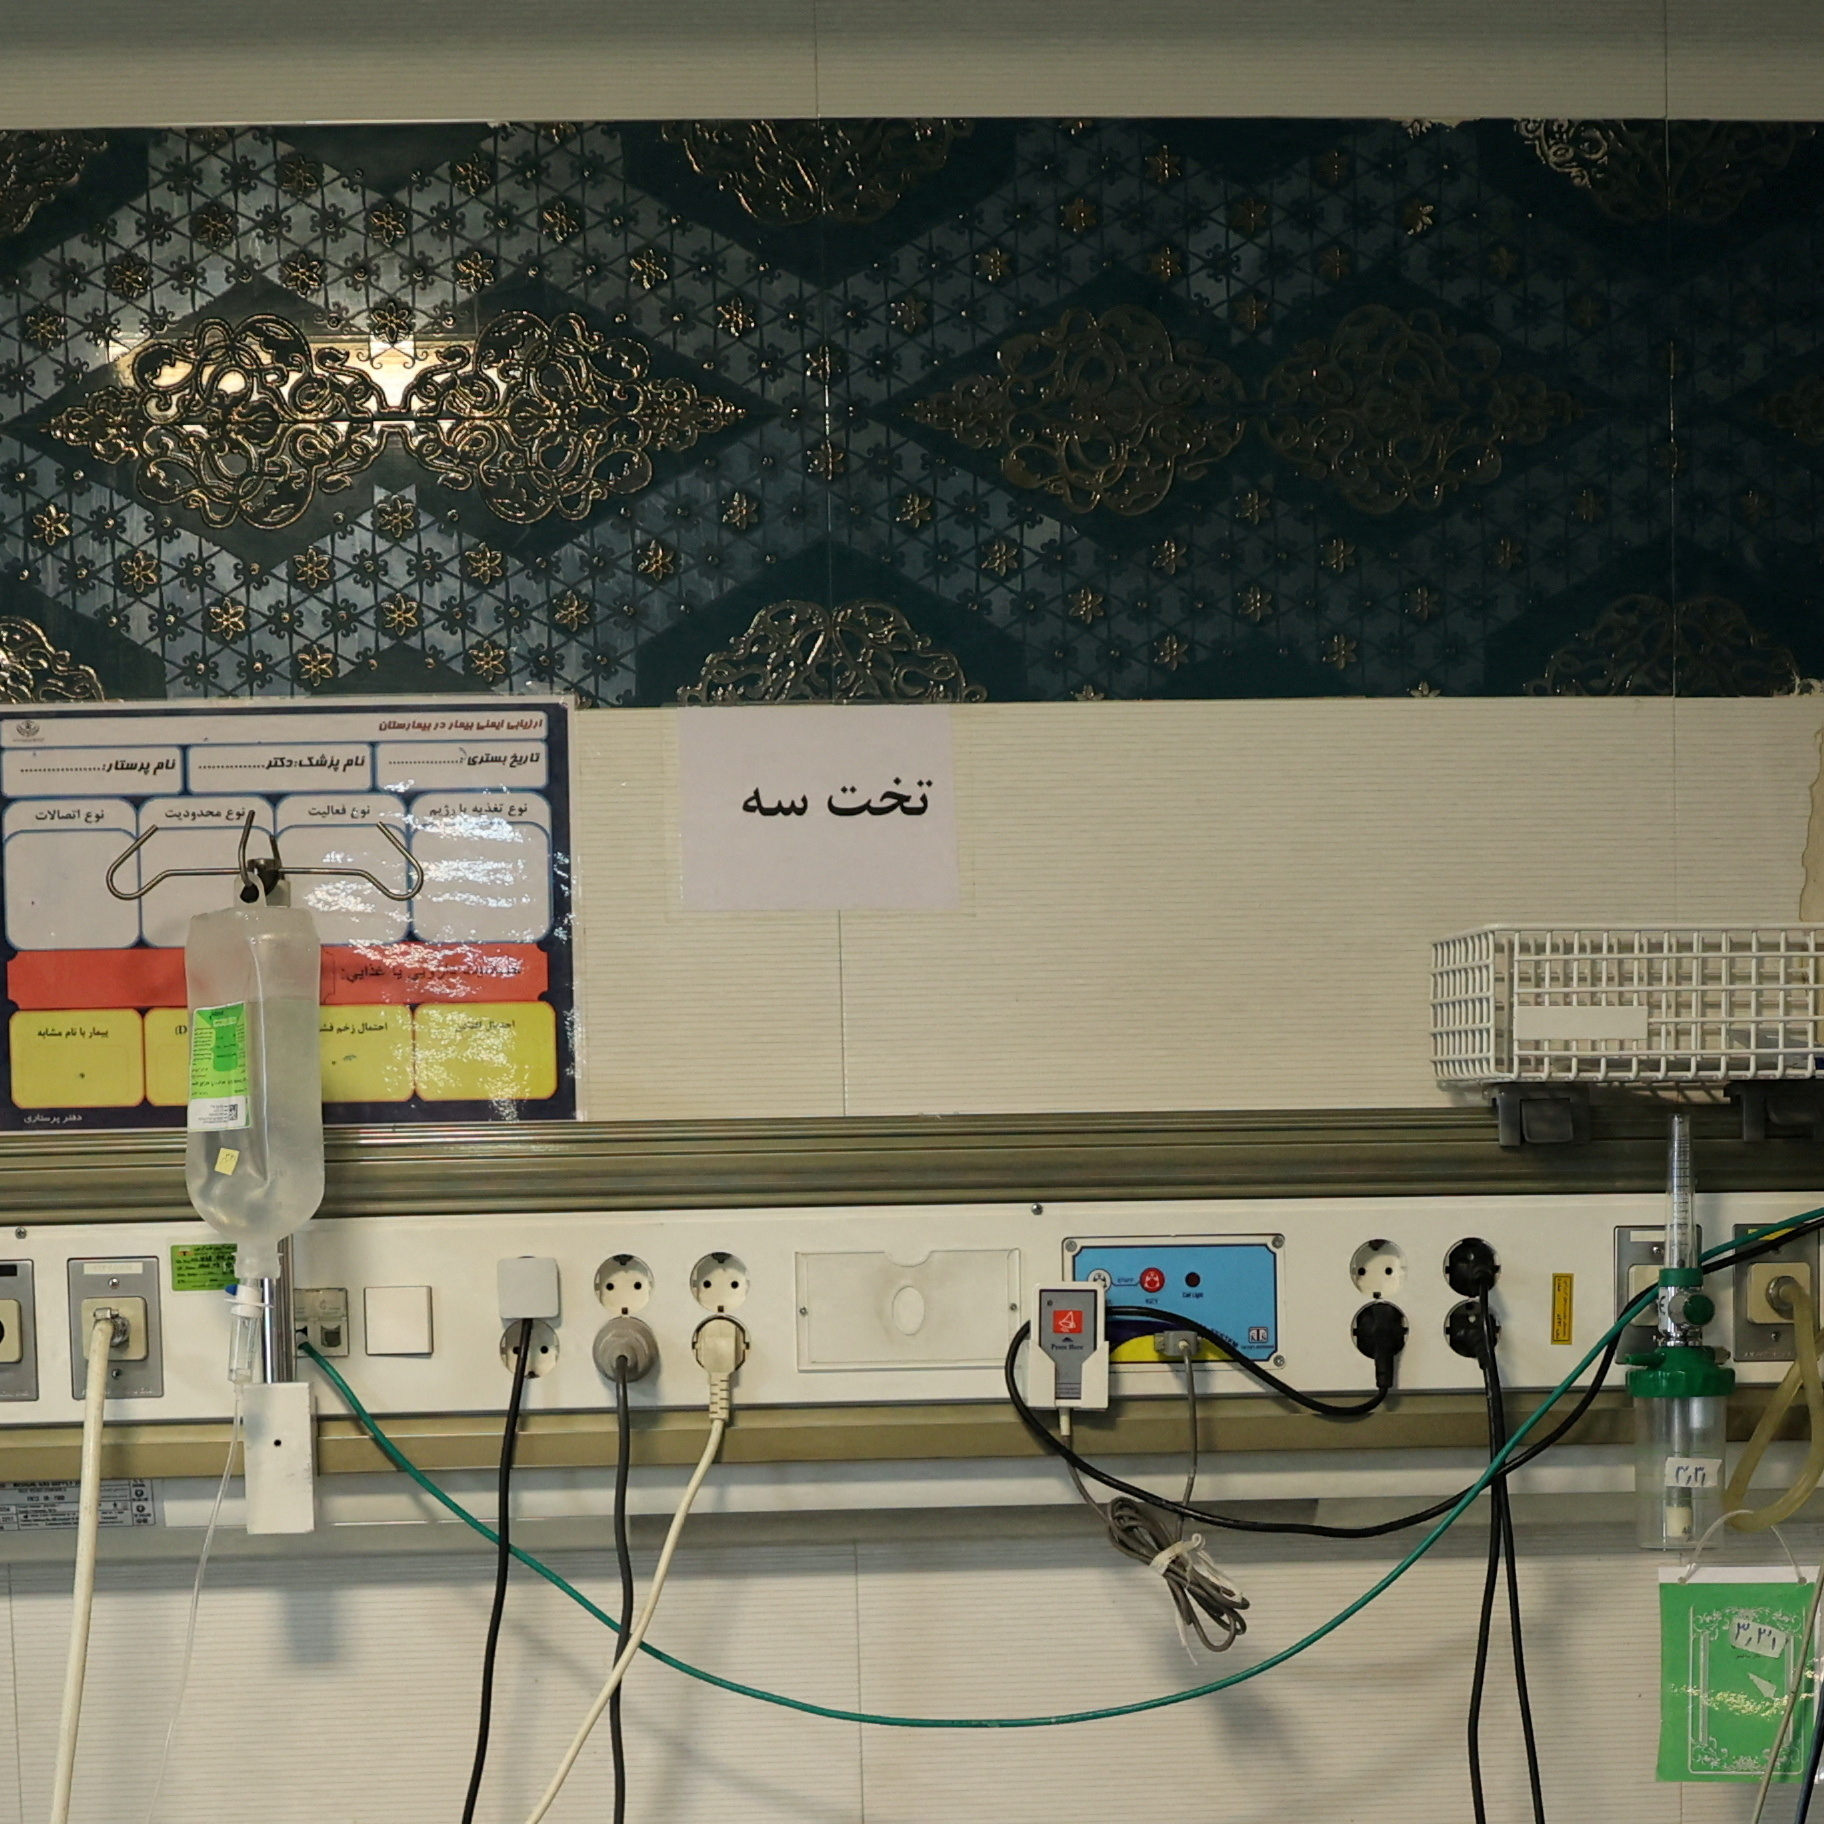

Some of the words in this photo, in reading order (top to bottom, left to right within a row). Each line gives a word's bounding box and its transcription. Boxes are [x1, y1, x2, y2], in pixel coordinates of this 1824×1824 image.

[379, 719, 433, 732] بیمارستان
[433, 721, 446, 731] در
[448, 719, 475, 731] بیمار
[476, 719, 505, 731] ایمنی
[507, 718, 543, 730] ارزیابی
[342, 755, 366, 772] نام
[509, 752, 541, 768] تاریخ
[153, 759, 176, 775] نام
[742, 786, 808, 817] سه
[827, 776, 934, 817] تخت
[225, 808, 246, 821] نوع
[308, 806, 347, 817] فعالیت
[350, 806, 371, 819] نوع
[472, 803, 504, 814] تغذیه
[508, 802, 529, 816] نوع
[35, 809, 81, 821] اتصالات
[84, 809, 105, 823] نوع
[165, 808, 222, 822] محدودیت
[37, 1027, 63, 1039] مشابه
[65, 1028, 77, 1039] نام
[88, 1026, 109, 1039] بیمار
[336, 1023, 356, 1035] زخم
[358, 1022, 388, 1034] احتمال
[23, 1113, 61, 1124] پرستاری
[62, 1113, 83, 1123] دفتر
[1050, 1343, 1066, 1351] Press
[1066, 1343, 1084, 1351] Here
